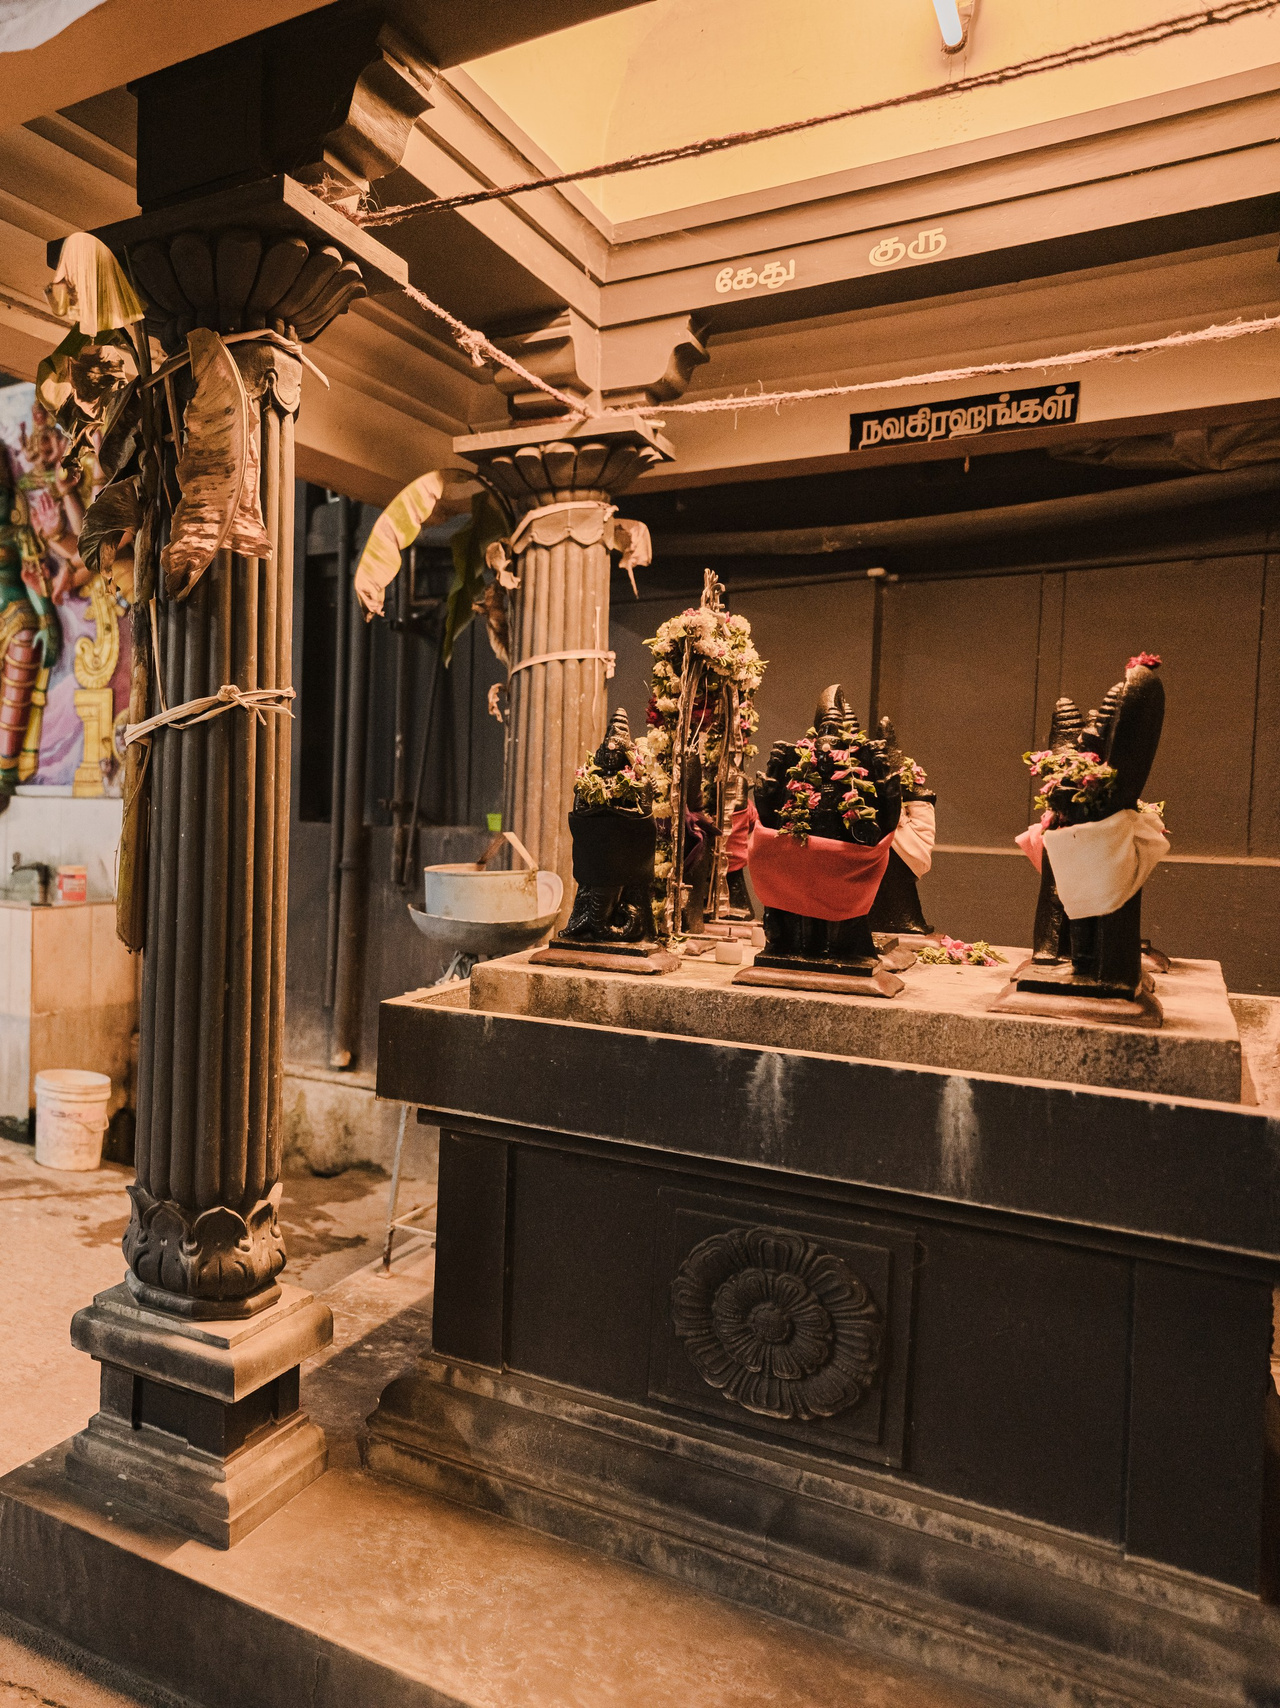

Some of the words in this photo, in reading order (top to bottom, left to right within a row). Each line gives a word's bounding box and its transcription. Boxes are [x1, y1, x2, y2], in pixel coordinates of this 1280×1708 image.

[869, 227, 947, 267] குரு
[715, 259, 795, 293] கேது
[858, 385, 1075, 450] நவகிரஹங்கள்
